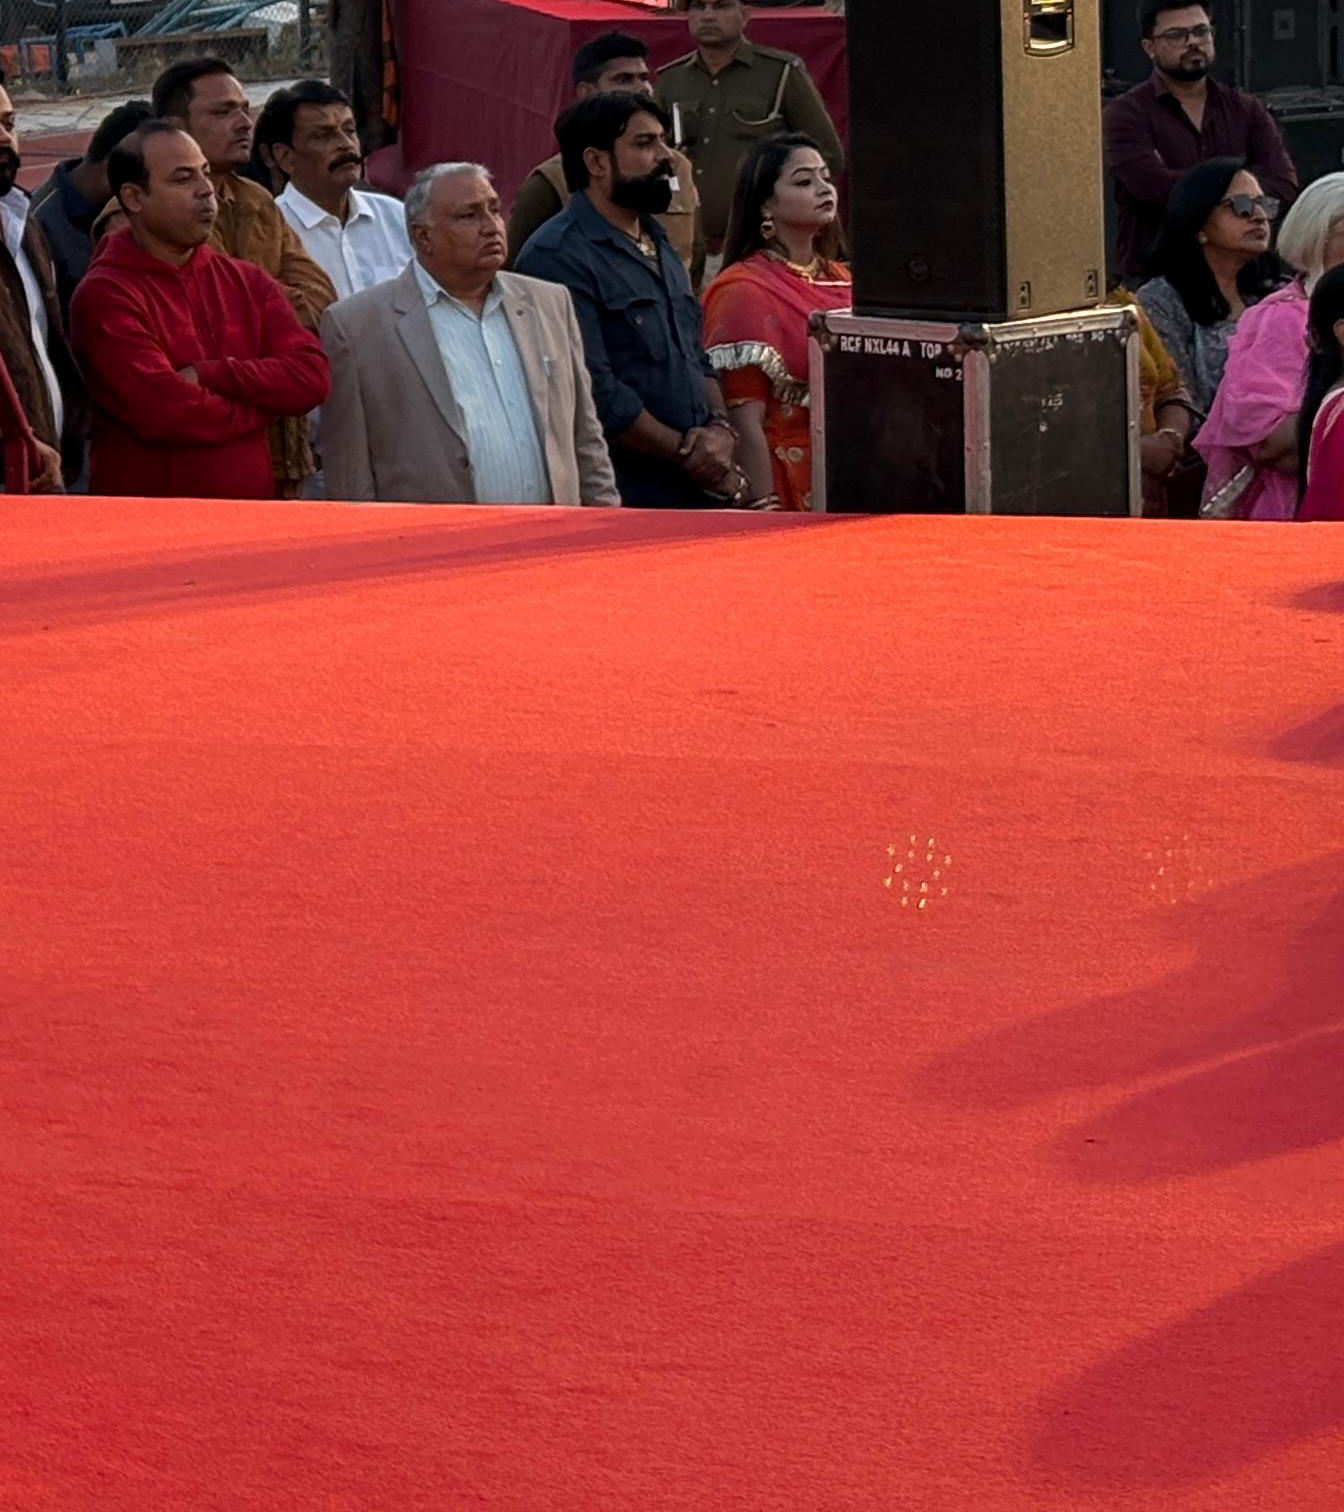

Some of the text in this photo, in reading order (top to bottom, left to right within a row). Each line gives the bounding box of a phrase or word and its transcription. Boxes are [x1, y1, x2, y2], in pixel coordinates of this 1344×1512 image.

[840, 335, 942, 359] RCF NXL44 A TOP
[955, 370, 962, 381] 2
